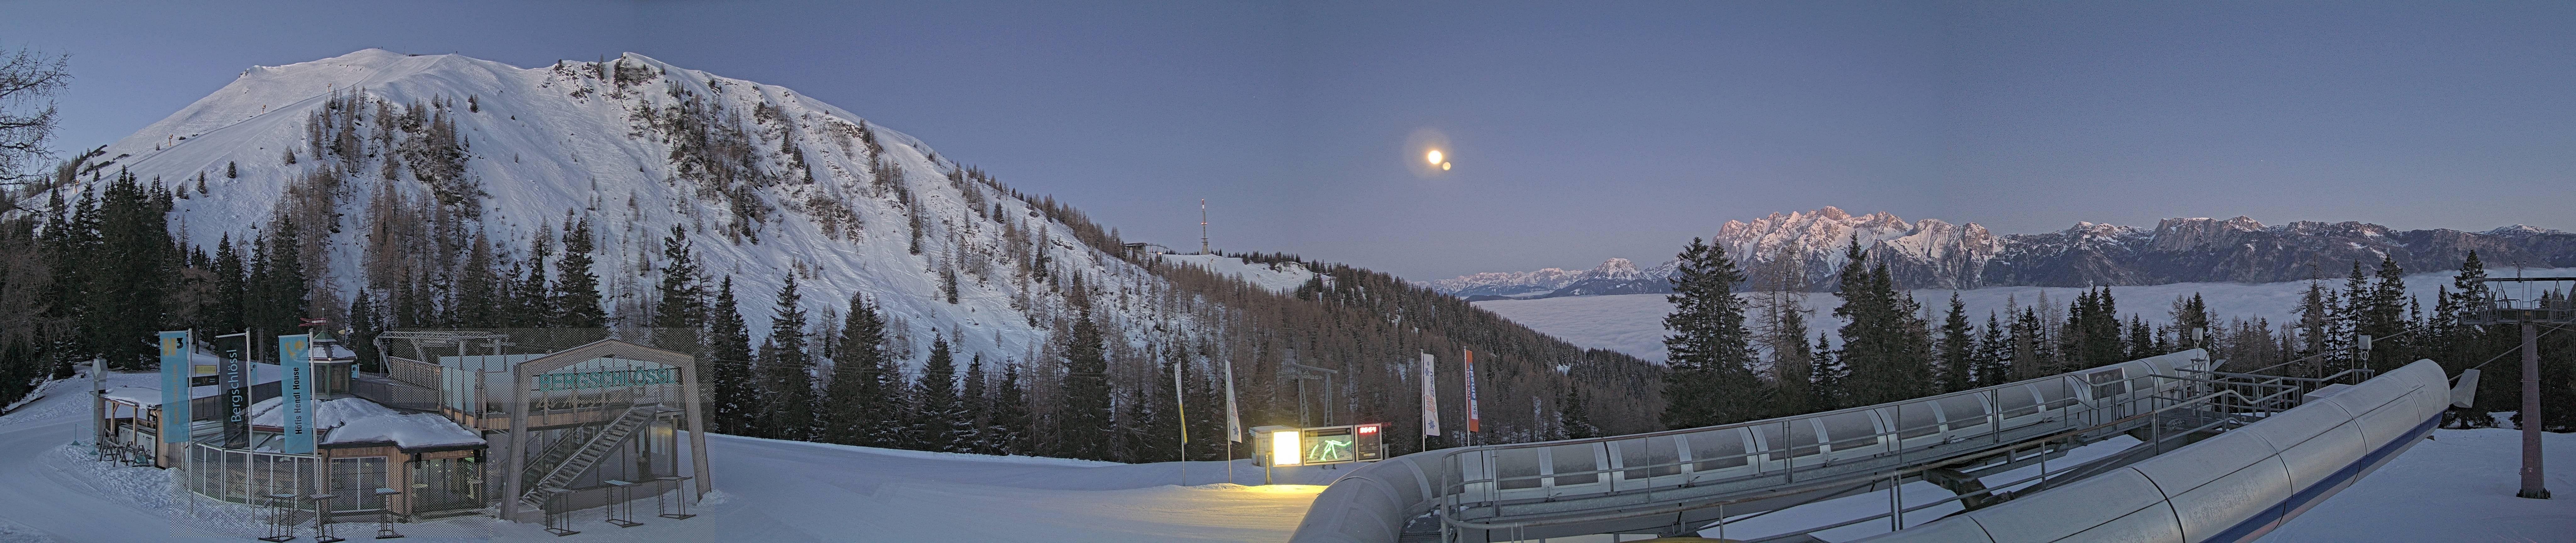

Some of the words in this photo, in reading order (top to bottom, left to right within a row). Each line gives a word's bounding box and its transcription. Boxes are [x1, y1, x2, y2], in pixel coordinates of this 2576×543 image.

[226, 349, 242, 422] Bergschlössl
[539, 367, 676, 392] BERGSCHLÖSSL
[294, 416, 302, 434] Höfis
